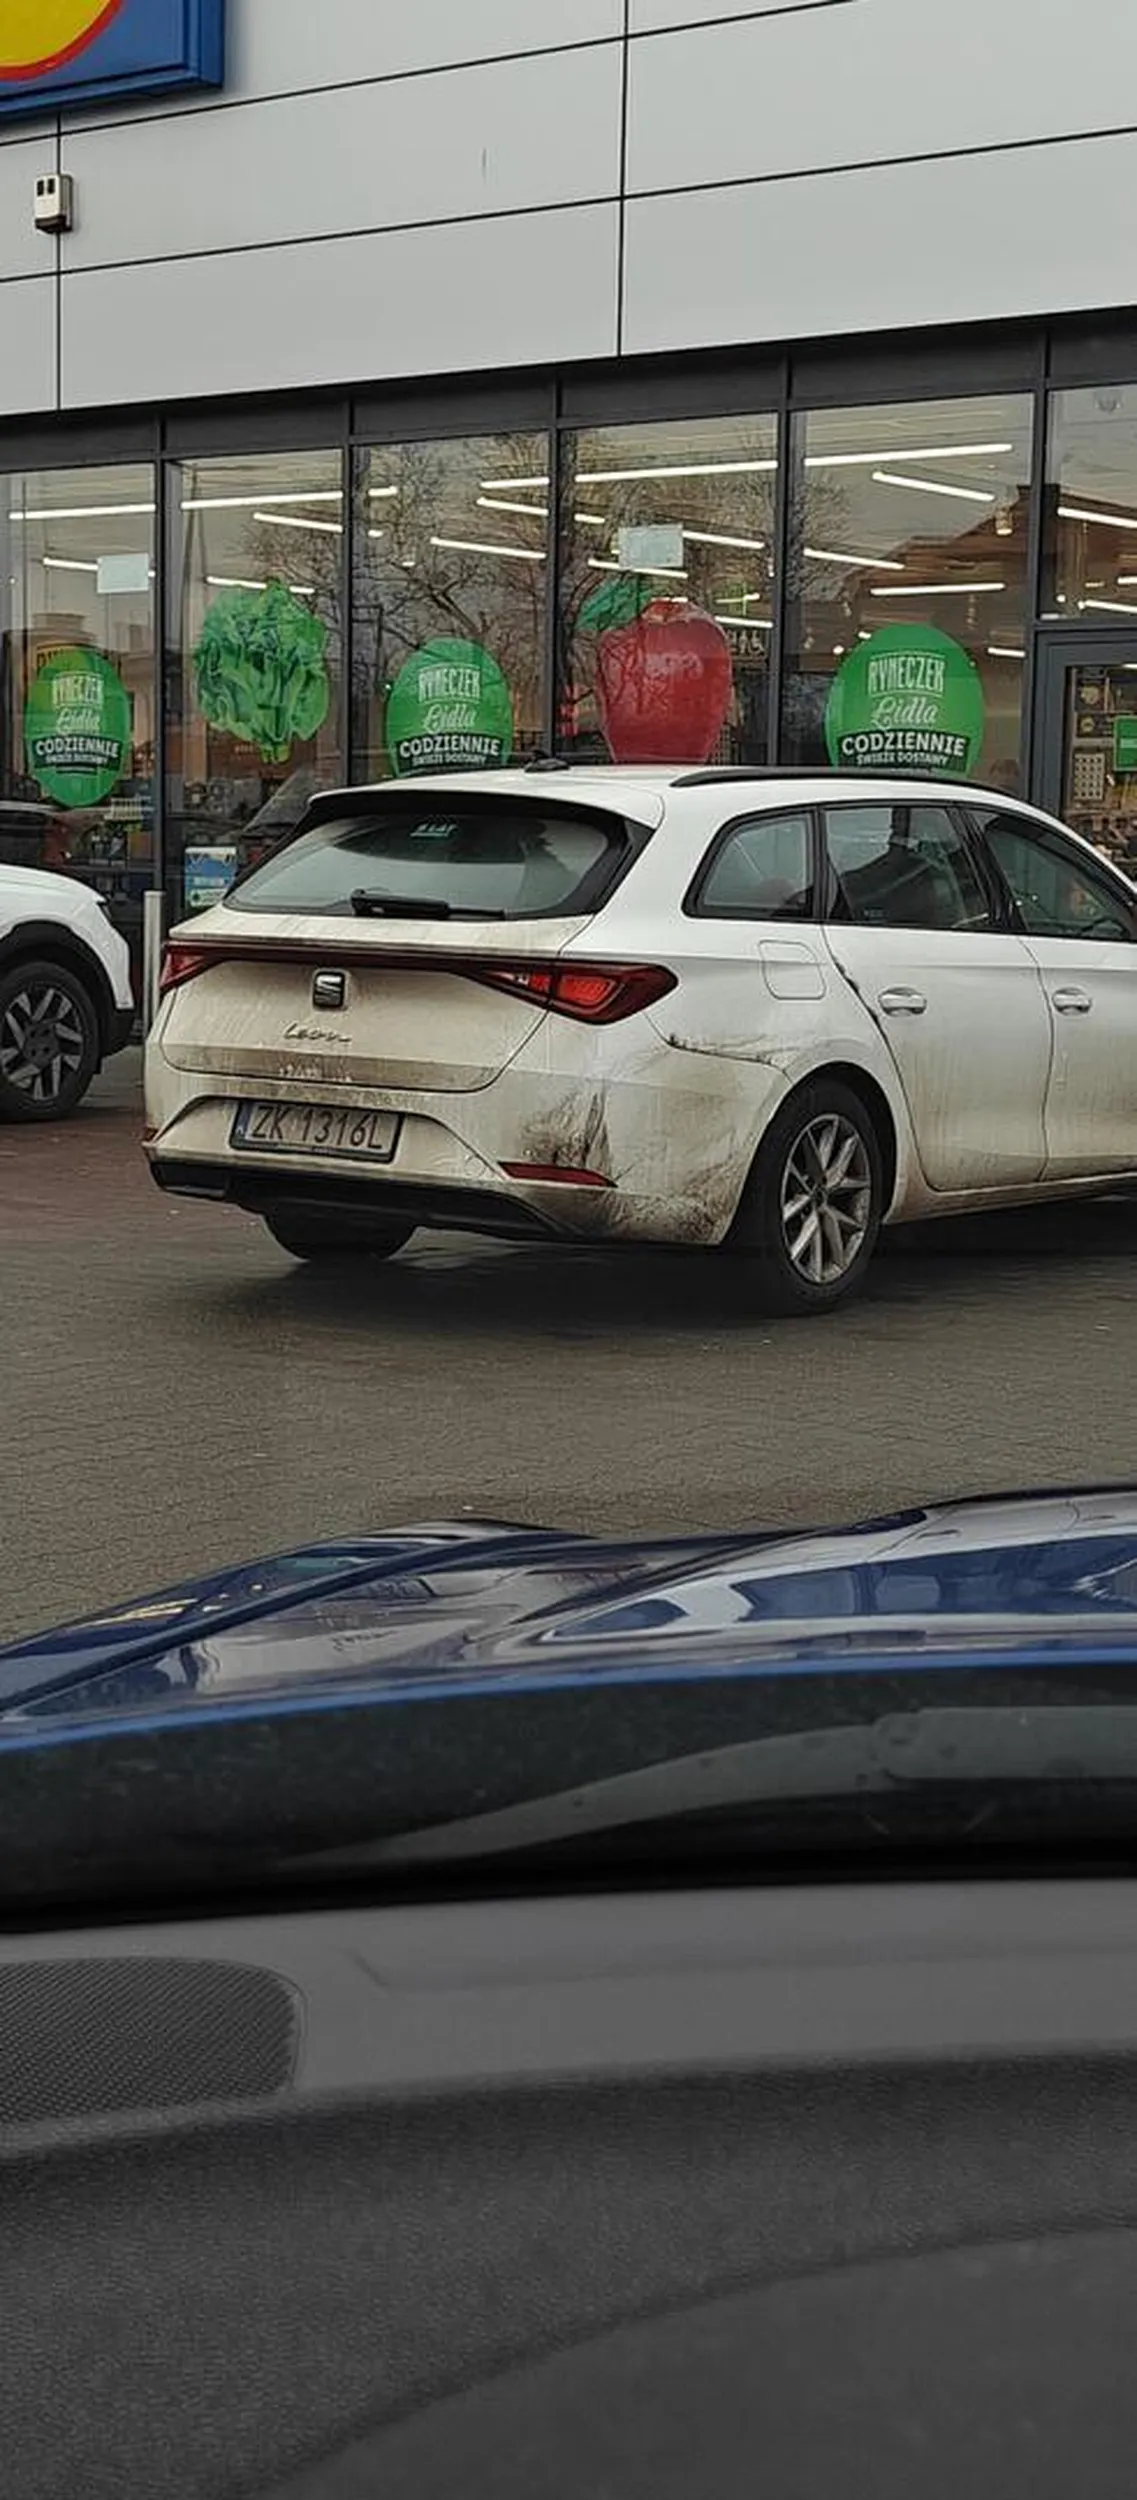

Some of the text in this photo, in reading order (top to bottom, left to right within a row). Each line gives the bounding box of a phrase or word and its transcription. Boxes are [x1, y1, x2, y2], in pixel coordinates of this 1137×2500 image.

[419, 667, 481, 701] RYNECZEK
[868, 656, 945, 693] RYNECZEK
[424, 703, 477, 735] Lidla
[871, 696, 939, 730] Lidla
[35, 737, 119, 758] CODZIENNIE
[400, 735, 501, 758] CODZIENNIE
[841, 732, 966, 757] CODZIENNIE
[283, 1022, 353, 1043] Leon
[251, 1105, 383, 1149] ZK 1316L
